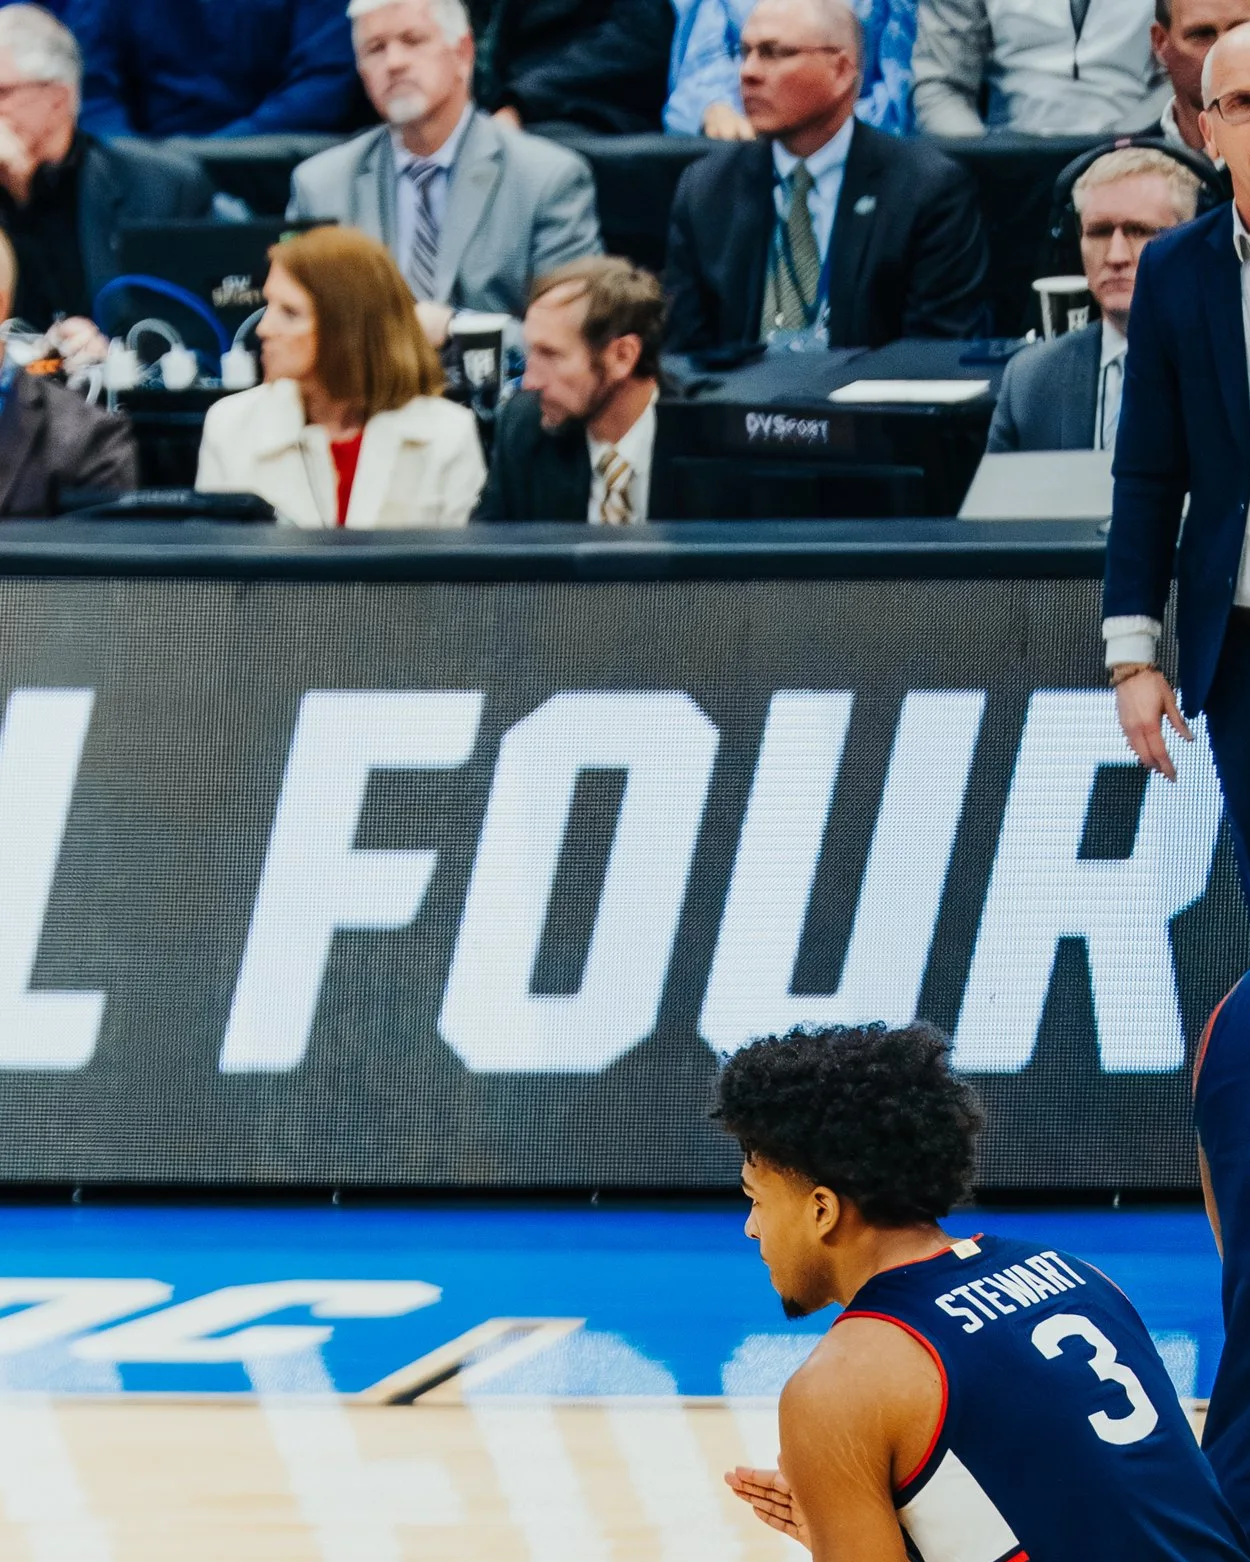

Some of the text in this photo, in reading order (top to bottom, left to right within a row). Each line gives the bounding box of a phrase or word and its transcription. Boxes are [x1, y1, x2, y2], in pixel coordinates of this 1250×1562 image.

[219, 688, 1225, 1074] FOUR
[935, 1250, 1086, 1334] STEWART
[1031, 1313, 1159, 1445] 3
